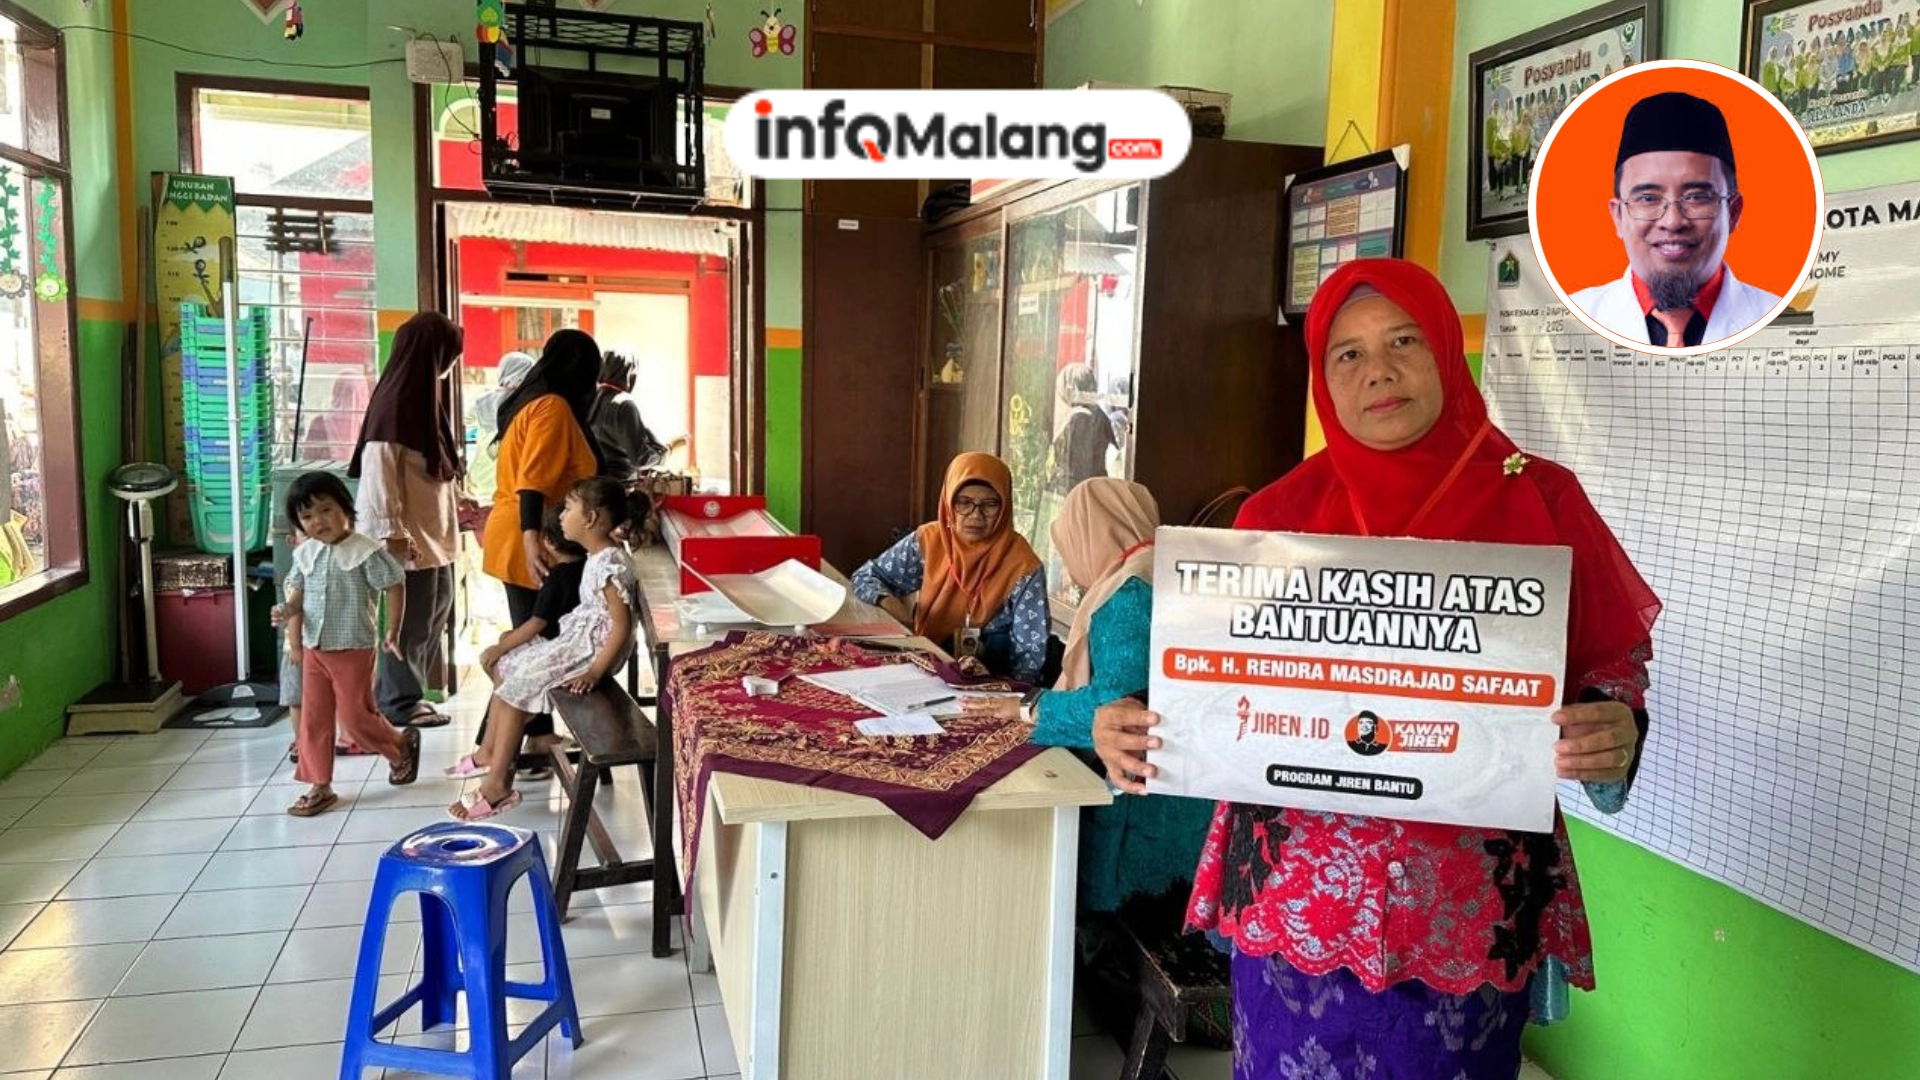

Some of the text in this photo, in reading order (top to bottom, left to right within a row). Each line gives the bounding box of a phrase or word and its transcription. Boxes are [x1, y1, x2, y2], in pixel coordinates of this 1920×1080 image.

[1808, 0, 1883, 32] Posyandu
[1524, 50, 1592, 87] Posyandu
[173, 181, 214, 190] UKURAN
[194, 192, 228, 202] BADAN
[1823, 204, 1880, 229] OTA
[1818, 251, 1840, 263] MY
[1176, 561, 1545, 617] TERIMA KASIH ATAS
[1230, 603, 1481, 653] BANTUANNYA
[1174, 653, 1542, 697] Bpk. H. RENDRA MASDRAJAD SAFAAT
[1394, 723, 1456, 736] KAWAN
[1398, 735, 1450, 748] JIREN
[1273, 769, 1415, 795] PROGRAM JIREN BANTU
